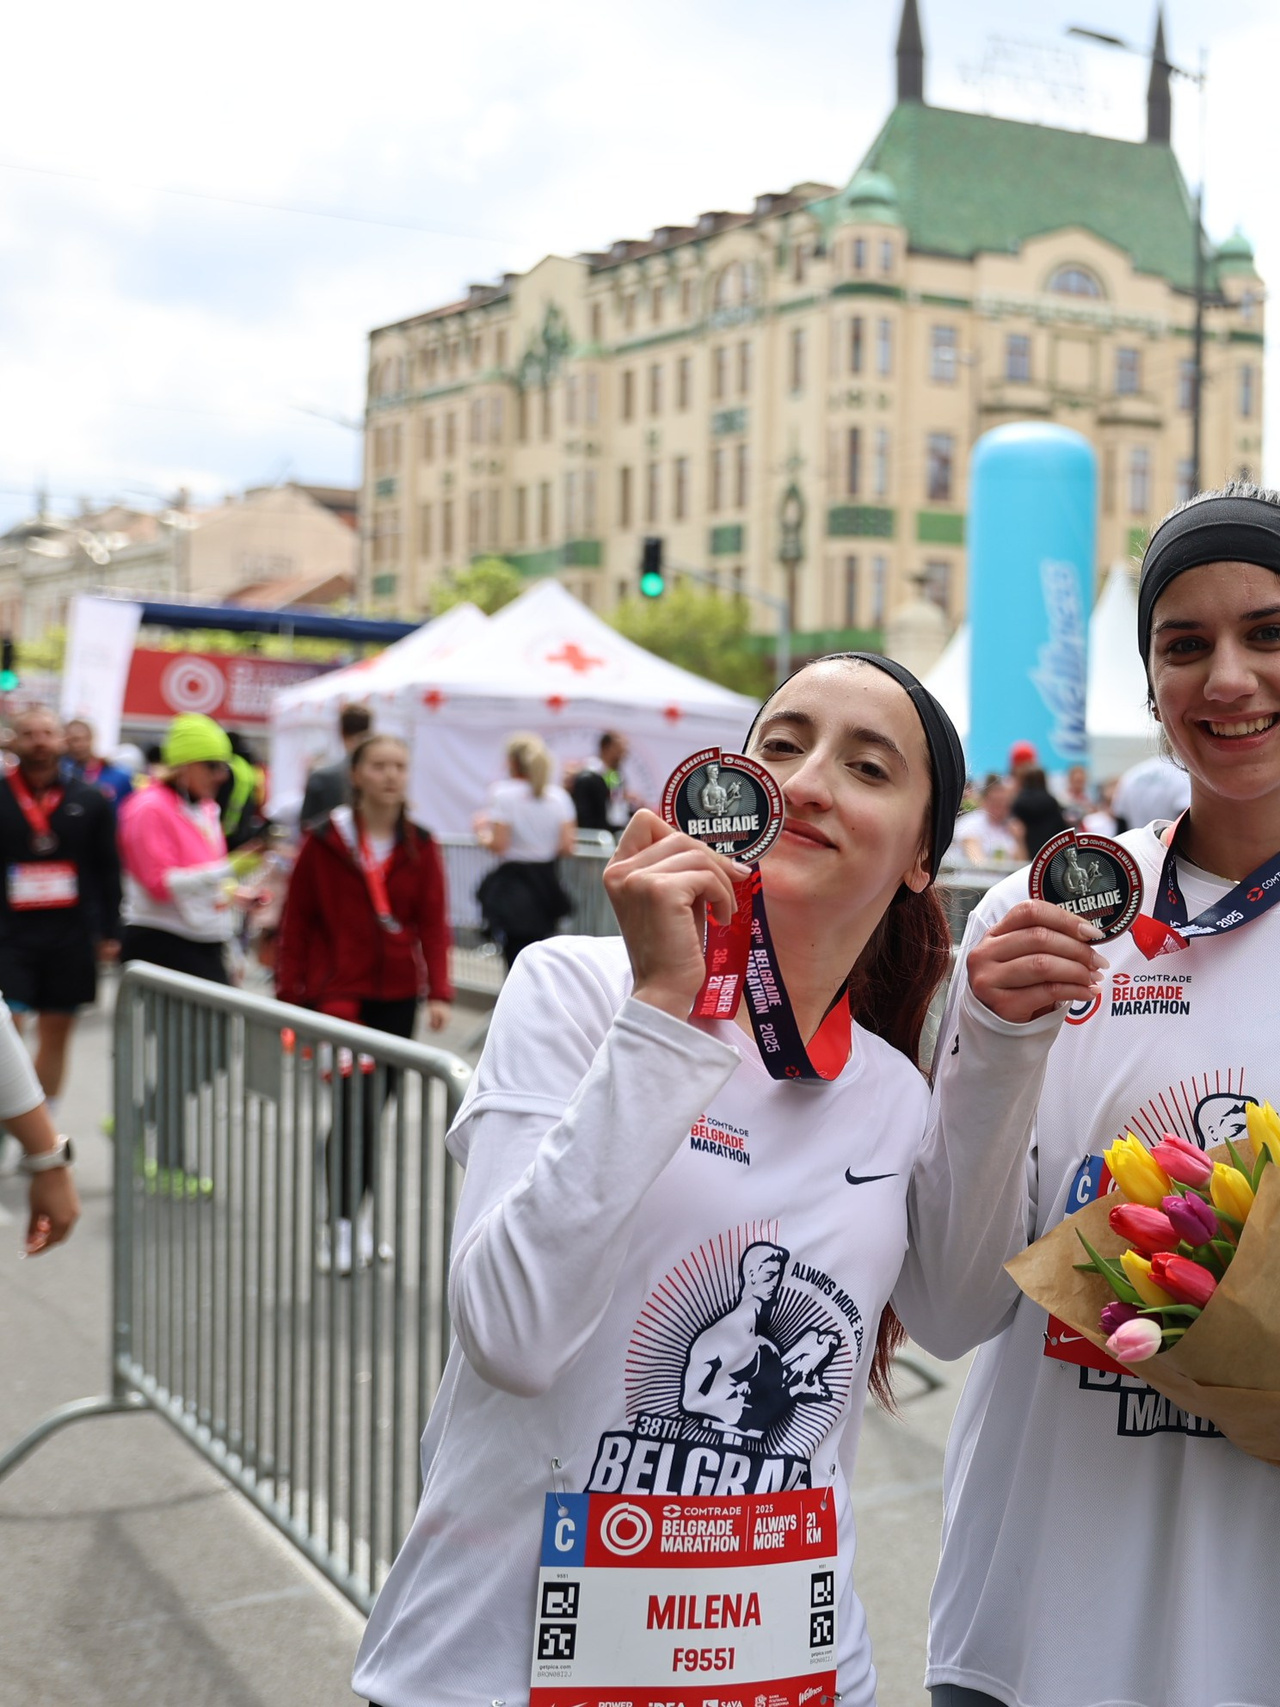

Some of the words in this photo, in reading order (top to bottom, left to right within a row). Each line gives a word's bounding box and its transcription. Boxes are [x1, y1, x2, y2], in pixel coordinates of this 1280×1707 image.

[688, 814, 759, 836] BELGRADE
[715, 841, 735, 853] 21K
[1216, 910, 1244, 928] 2025
[753, 949, 782, 1007] BELGRADE
[1133, 974, 1192, 983] COMTRADE
[718, 974, 739, 1013] FINISHER
[1112, 985, 1183, 1001] BELGRADE
[1111, 1000, 1190, 1016] MARATHON
[759, 1023, 780, 1054] 2025
[707, 1116, 749, 1137] COMTRADE
[691, 1124, 744, 1151] BELGRADE
[690, 1137, 750, 1166] MARATHON
[1077, 1175, 1092, 1204] C
[791, 1262, 836, 1296] ALWAYS
[832, 1289, 862, 1328] MORE
[637, 1417, 683, 1440] 38TH
[684, 1506, 742, 1516] COMTRADE
[755, 1504, 774, 1514] 2025
[806, 1512, 816, 1527] 21
[661, 1519, 733, 1536] BELGRADE
[754, 1514, 797, 1534] ALWAYS
[554, 1518, 575, 1552] C
[661, 1536, 740, 1552] MARATHON
[753, 1532, 785, 1550] MORE
[806, 1528, 821, 1544] KM
[646, 1591, 762, 1630] MILENA
[672, 1647, 735, 1672] F9551
[798, 1685, 823, 1706] Wellness
